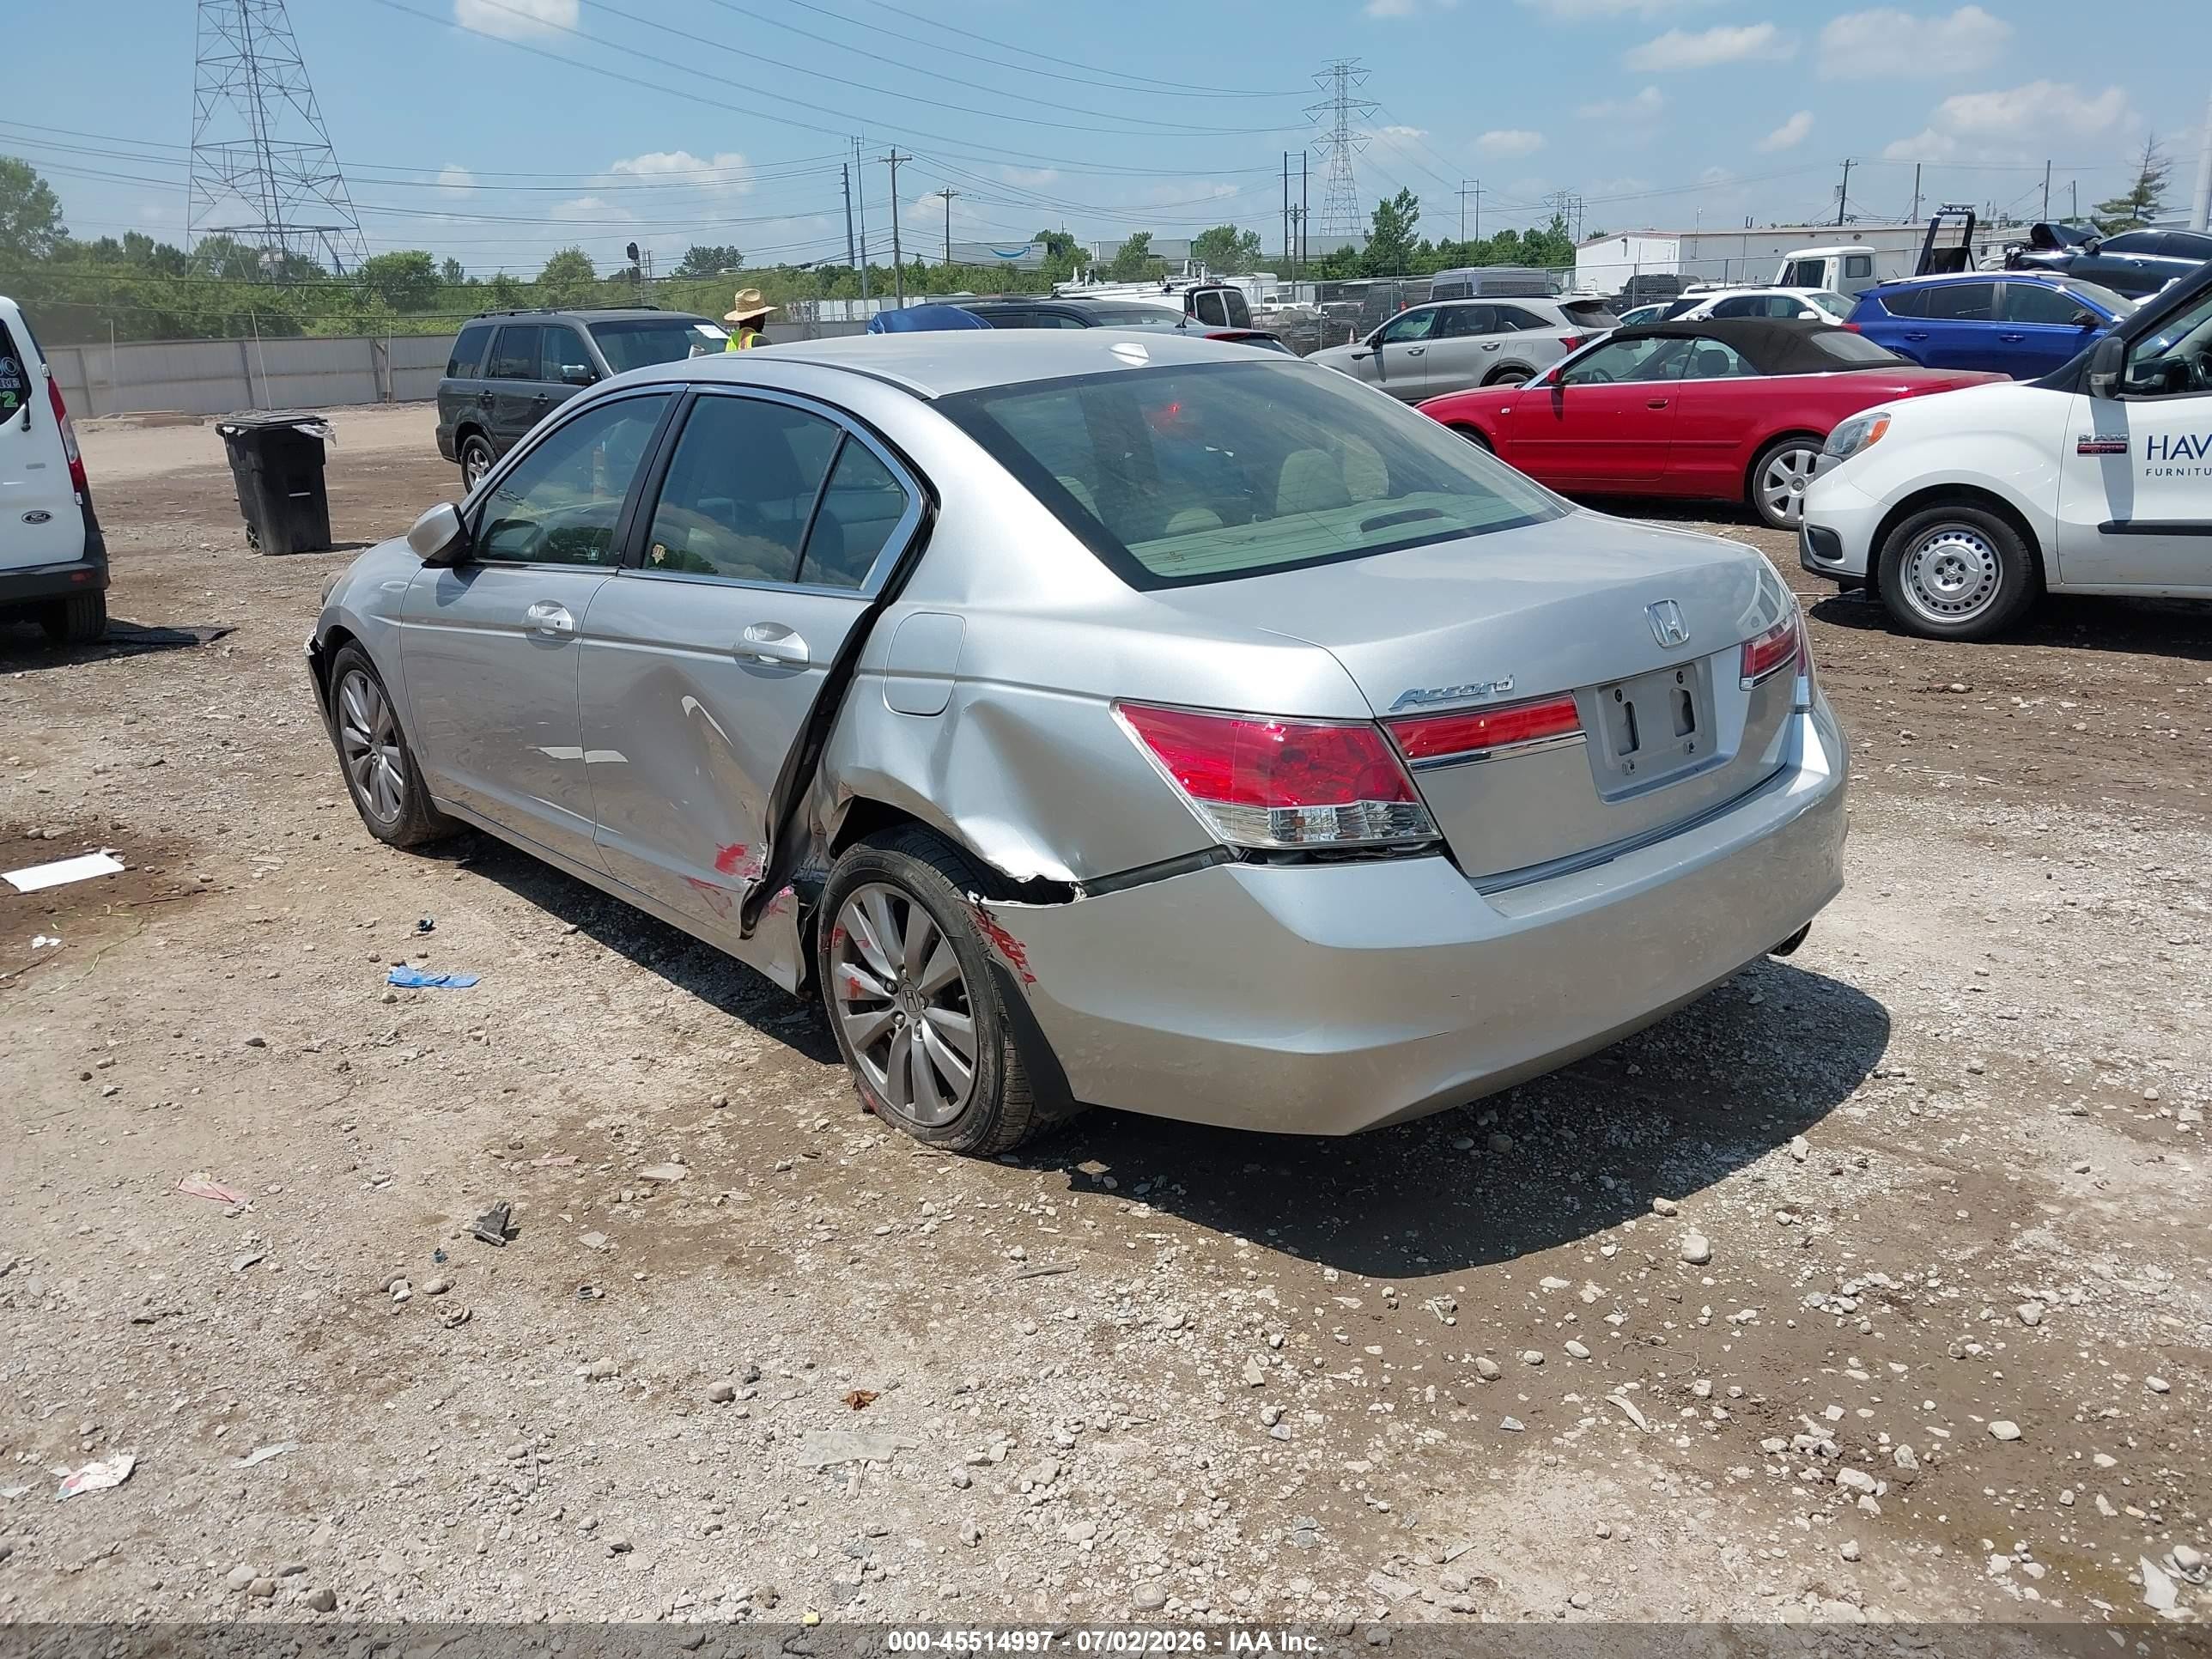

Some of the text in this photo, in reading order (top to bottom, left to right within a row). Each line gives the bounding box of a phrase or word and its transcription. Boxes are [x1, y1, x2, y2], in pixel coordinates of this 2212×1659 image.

[2146, 434, 2212, 461] HAV
[2145, 467, 2212, 477] FURNITU
[1387, 673, 1516, 712] Accord
